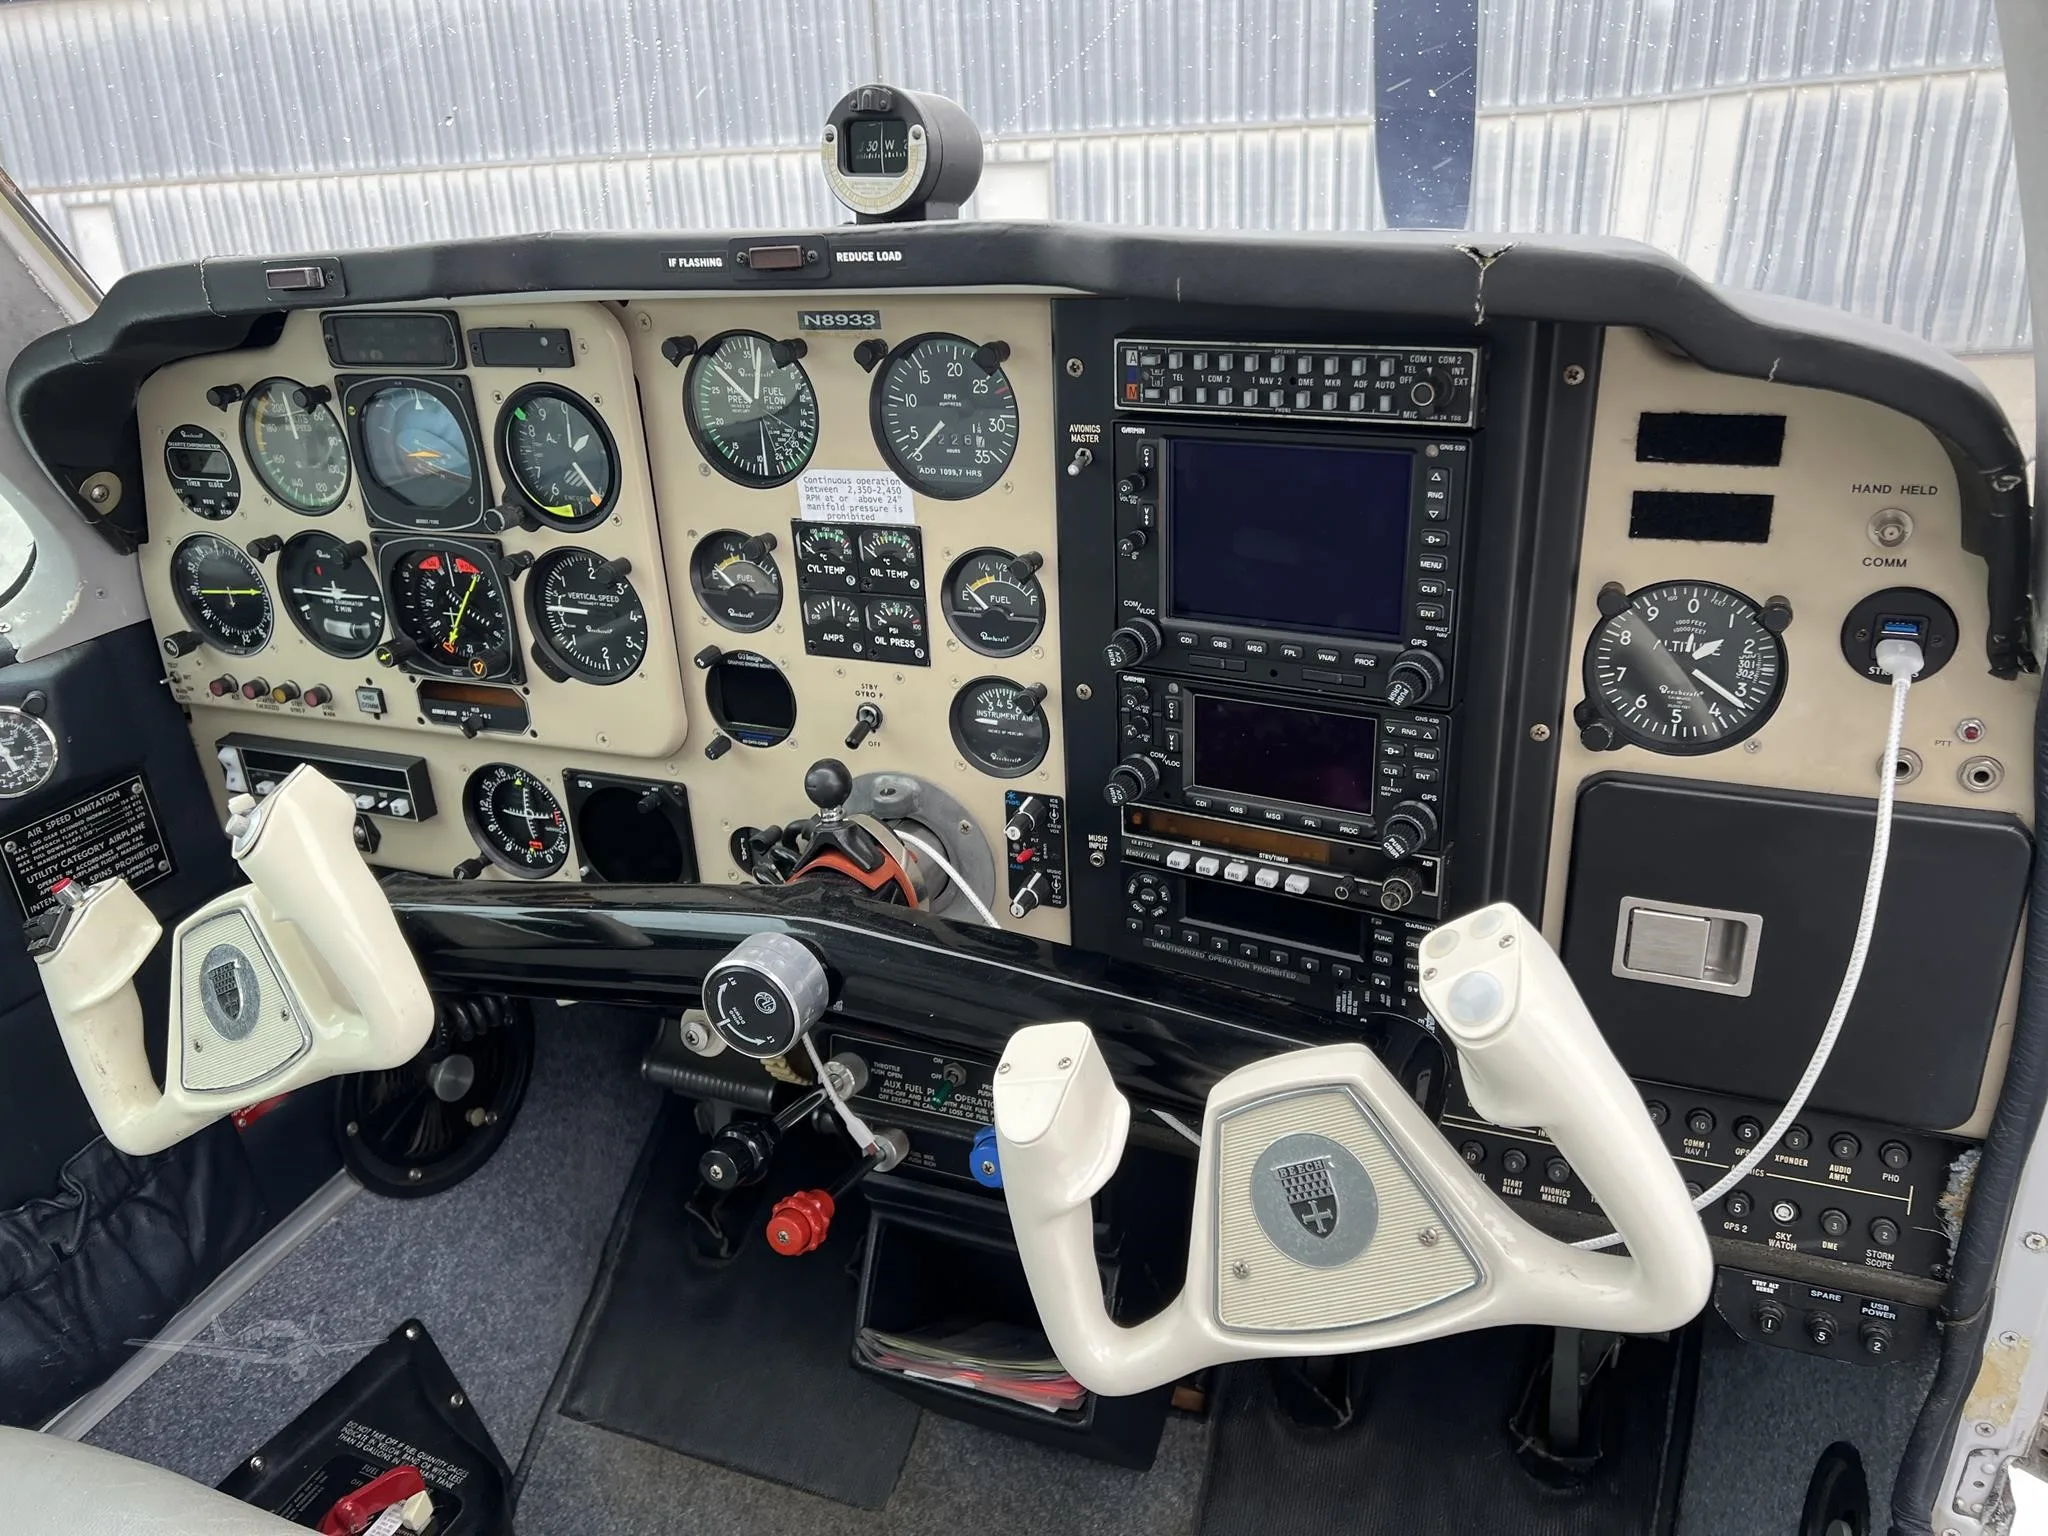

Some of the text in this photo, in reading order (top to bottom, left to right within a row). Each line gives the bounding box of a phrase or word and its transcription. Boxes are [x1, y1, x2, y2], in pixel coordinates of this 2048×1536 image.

[836, 250, 902, 262] REDUCE LOAD
[668, 257, 723, 268] IF FLASHING
[804, 313, 876, 327] N8933
[1410, 354, 1427, 364] COM
[1438, 356, 1456, 364] COM
[947, 362, 963, 377] 20
[1404, 366, 1417, 374] TEL
[1452, 368, 1464, 376] INT
[920, 370, 930, 384] 15
[1172, 374, 1184, 382] TEL
[1208, 376, 1222, 384] COM
[1400, 376, 1413, 384] OFF
[1454, 378, 1468, 386] EXT
[973, 380, 988, 394] 25
[1375, 381, 1394, 389] AUTO
[763, 386, 784, 396] FUEL
[764, 396, 786, 405] FLOW
[906, 393, 917, 408] 10
[1403, 411, 1418, 420] MIC
[988, 418, 1006, 432] 30
[1070, 424, 1100, 433] AVIONICS
[1071, 434, 1099, 443] MASTER
[974, 450, 990, 464] 35
[803, 476, 901, 488] Continuous operation
[805, 485, 838, 494] between
[1852, 484, 1938, 496] HAND HELD
[858, 496, 882, 504] above
[1428, 492, 1444, 500] RNG
[807, 502, 903, 515] manifold pressure is
[827, 512, 876, 522] prohibited
[978, 562, 990, 572] 1/4
[996, 562, 1008, 572] 1/2
[1420, 561, 1442, 569] MENU
[1862, 557, 1908, 568] COMM
[807, 564, 846, 575] CYL TEMP
[870, 568, 909, 579] OIL TEMP
[568, 592, 620, 604] VERTICAL SPEED
[990, 595, 1011, 604] FUEL
[1688, 598, 1700, 614] 0
[1420, 610, 1436, 618] ENT
[1647, 606, 1659, 621] 9
[823, 633, 844, 643] AMPS
[874, 636, 916, 648] OIL PRESS
[1410, 638, 1428, 647] GPS
[1620, 630, 1632, 646] 8
[1213, 640, 1228, 648] OBS
[1248, 644, 1262, 652] MSG
[1743, 639, 1756, 654] 2
[1318, 654, 1336, 662] VNAV
[1354, 658, 1374, 666] PROC
[1616, 666, 1627, 682] 7
[1734, 682, 1747, 697] 3
[1635, 694, 1648, 709] 6
[1708, 702, 1721, 716] 4
[976, 710, 1019, 721] INSTRUMENT
[1671, 708, 1682, 724] 5
[1402, 728, 1417, 736] RNG
[1414, 752, 1434, 760] MENU
[1422, 794, 1437, 802] GPS
[27, 790, 121, 839] AIR SPEED LIMITATION
[1266, 812, 1280, 820] MSG
[1340, 826, 1358, 834] PROC
[1088, 834, 1108, 843] MUSIC
[1088, 842, 1108, 850] INPUT
[27, 821, 146, 884] UTILITY CATEGORY AIRPLANE
[90, 843, 160, 884] SPINS PROHIBITED
[1374, 934, 1392, 942] FUNC
[1152, 942, 1297, 980] UNAUTHORIZED OPERATION PROHIBITED
[884, 1080, 924, 1095] AUX FUEL
[1696, 1120, 1706, 1130] 10
[1744, 1128, 1752, 1138] 5
[1684, 1138, 1704, 1148] COMM
[1685, 1146, 1700, 1156] NAV
[1774, 1154, 1809, 1167] XPONDER
[1280, 1160, 1324, 1178] BEECH
[1829, 1164, 1852, 1174] AUDIO
[1828, 1173, 1848, 1182] AMPL
[1882, 1172, 1900, 1183] PHO
[1503, 1178, 1523, 1188] START
[1502, 1186, 1522, 1196] RELAY
[1540, 1185, 1571, 1198] AVIONICS
[1542, 1194, 1568, 1205] MASTER
[1724, 1222, 1748, 1233] GPS 2
[1775, 1232, 1792, 1241] SKY
[1768, 1238, 1797, 1251] WATCH
[1822, 1240, 1838, 1251] DME
[1866, 1249, 1895, 1262] STORM
[1865, 1258, 1893, 1270] SCOPE
[1810, 1290, 1842, 1302] SPARE
[1870, 1302, 1890, 1311] USB
[1862, 1307, 1896, 1320] POWER
[1818, 1332, 1826, 1341] 5
[1874, 1342, 1882, 1351] 2
